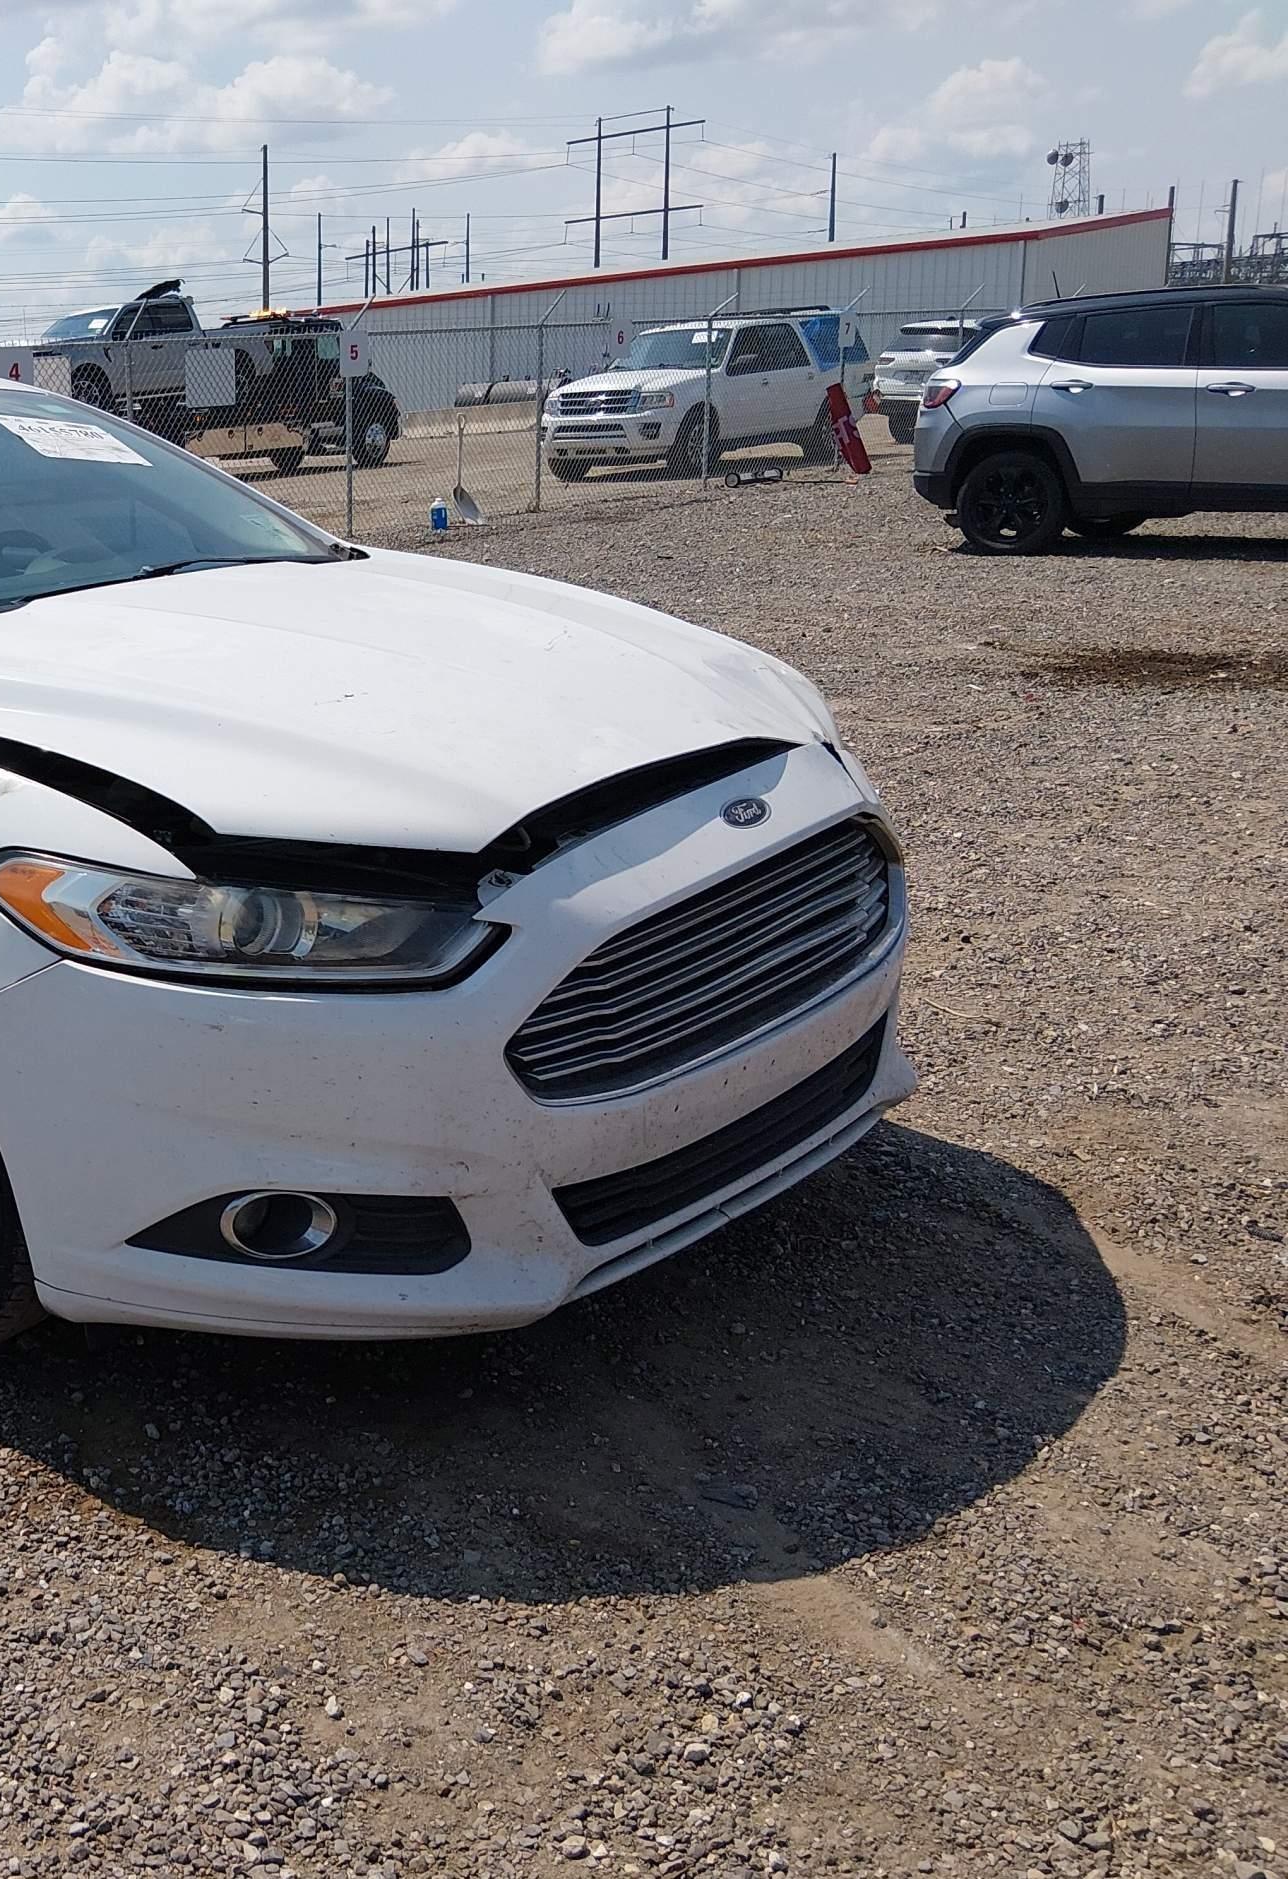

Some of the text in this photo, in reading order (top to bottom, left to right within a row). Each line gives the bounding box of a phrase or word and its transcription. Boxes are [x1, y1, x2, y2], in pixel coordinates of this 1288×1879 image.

[844, 322, 851, 335] 7
[617, 330, 624, 345] 6
[350, 344, 359, 361] 5
[8, 362, 21, 381] 4
[731, 803, 762, 823] Ford
